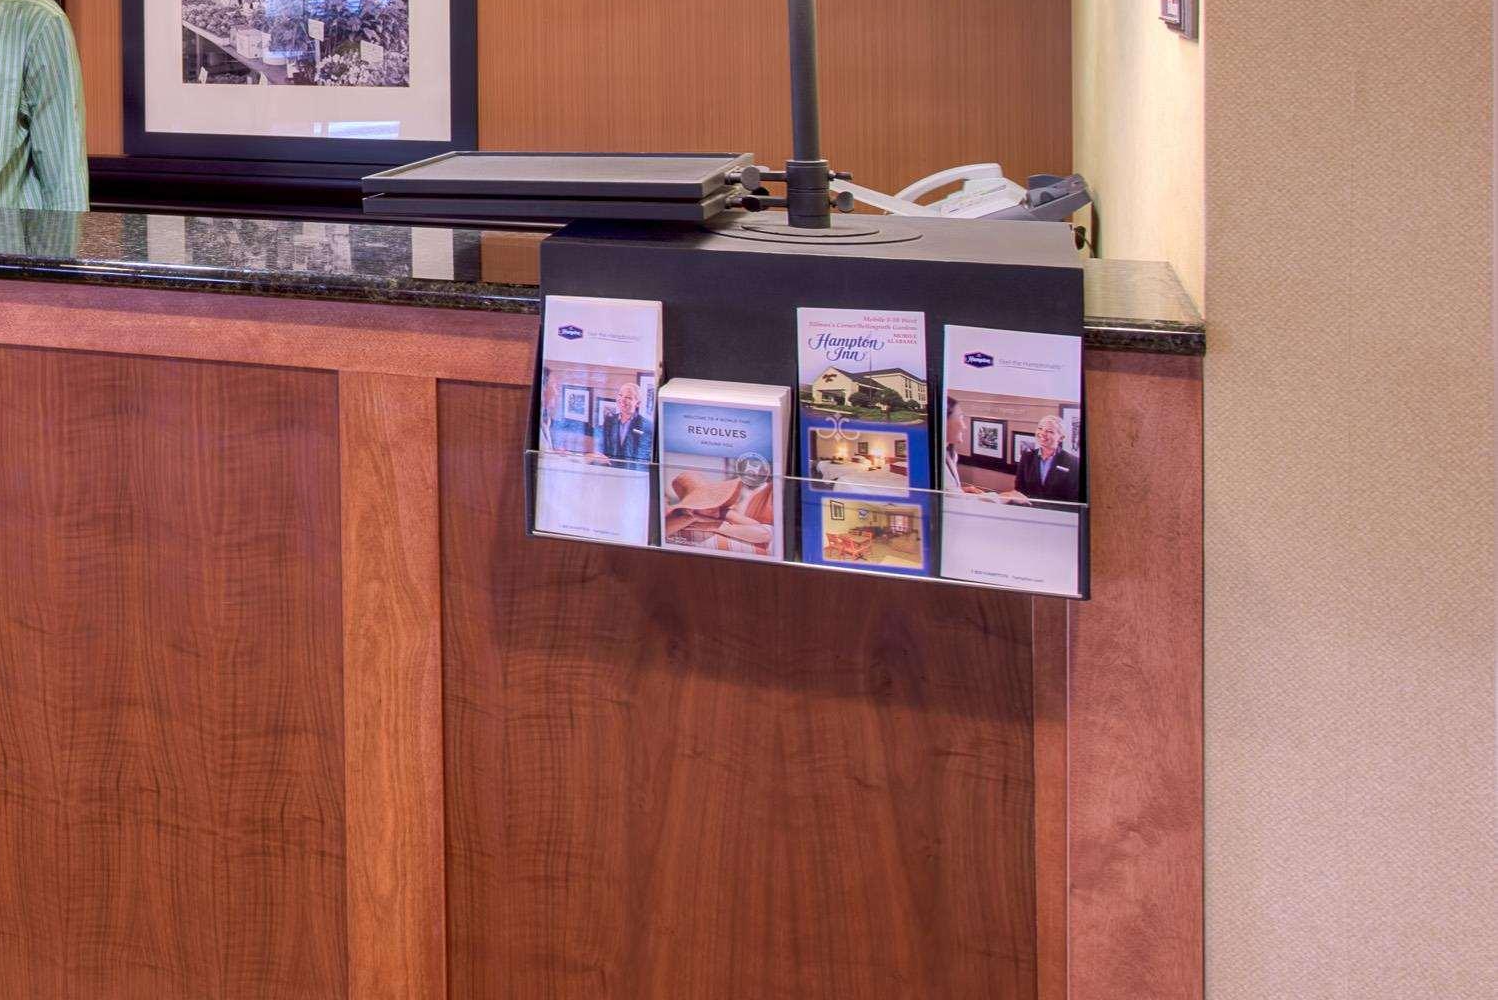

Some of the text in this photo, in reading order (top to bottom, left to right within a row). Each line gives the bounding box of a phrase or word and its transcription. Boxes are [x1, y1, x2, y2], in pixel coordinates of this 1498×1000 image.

[807, 332, 885, 351] Hampton
[826, 347, 866, 362] Inn
[687, 425, 747, 439] REVOLVES
